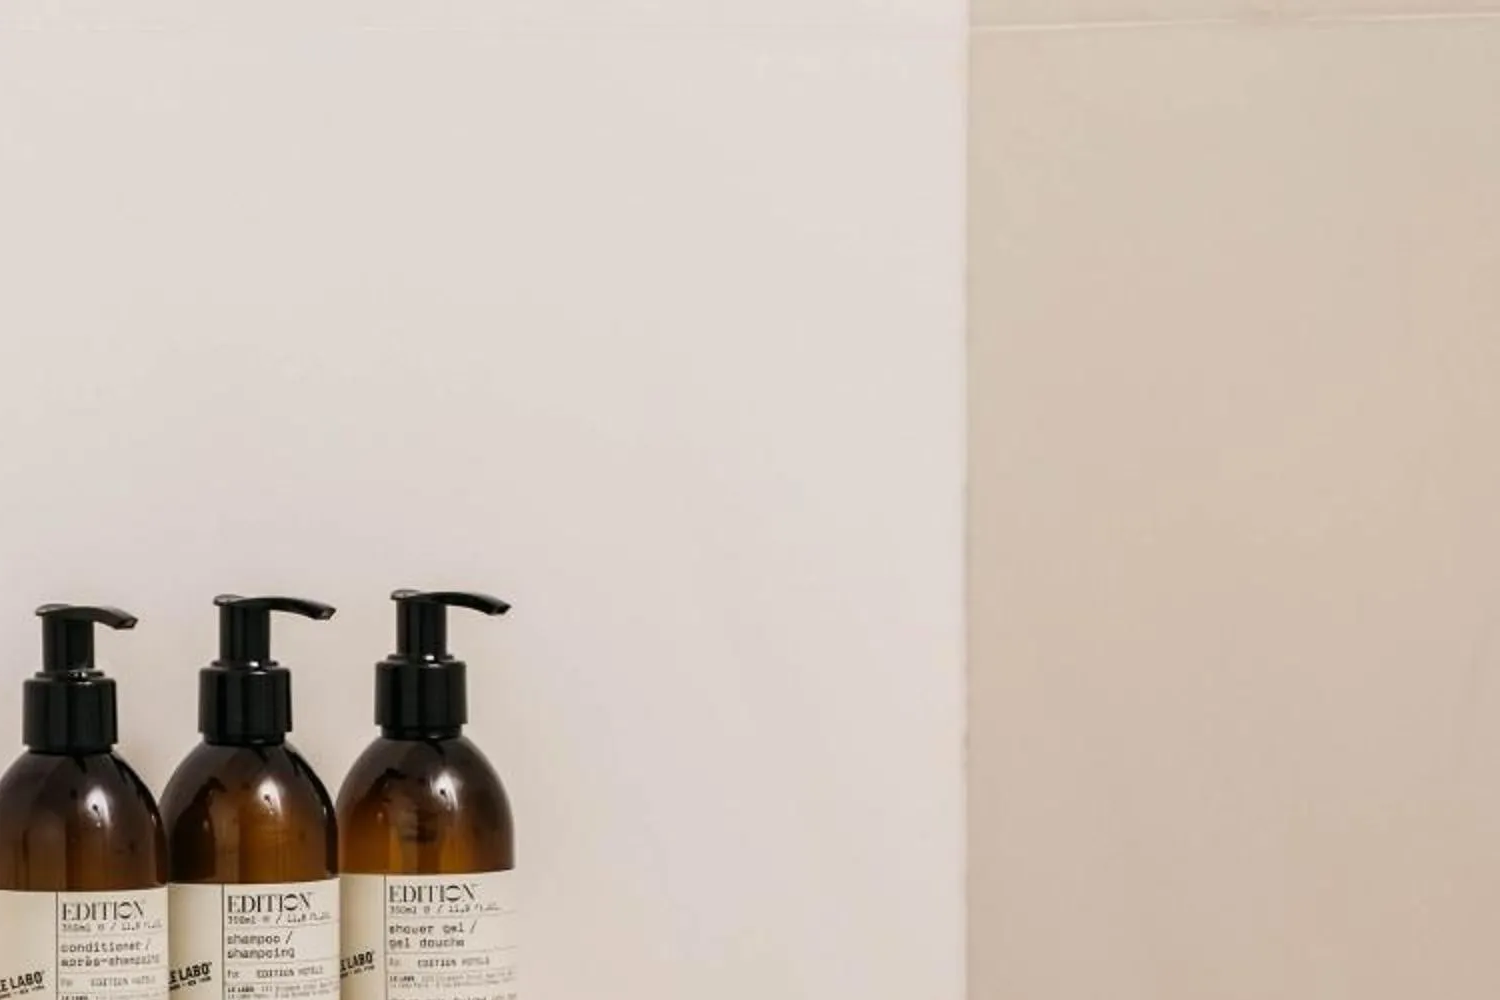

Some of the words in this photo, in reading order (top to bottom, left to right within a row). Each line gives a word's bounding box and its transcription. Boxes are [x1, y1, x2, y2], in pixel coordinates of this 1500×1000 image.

[389, 884, 475, 903] EDITION
[62, 900, 143, 921] EDITION
[227, 893, 311, 913] EDITION
[389, 922, 435, 935] shower
[442, 921, 466, 936] gel
[227, 934, 281, 946] shampoo
[389, 937, 411, 951] gel
[419, 937, 466, 949] douche
[227, 947, 296, 960] shampoing
[347, 951, 374, 970] LABO
[417, 958, 457, 969] EDITION
[9, 971, 43, 989] LABO
[168, 968, 178, 984] E
[178, 962, 211, 981] LABO
[255, 967, 295, 979] EDITION
